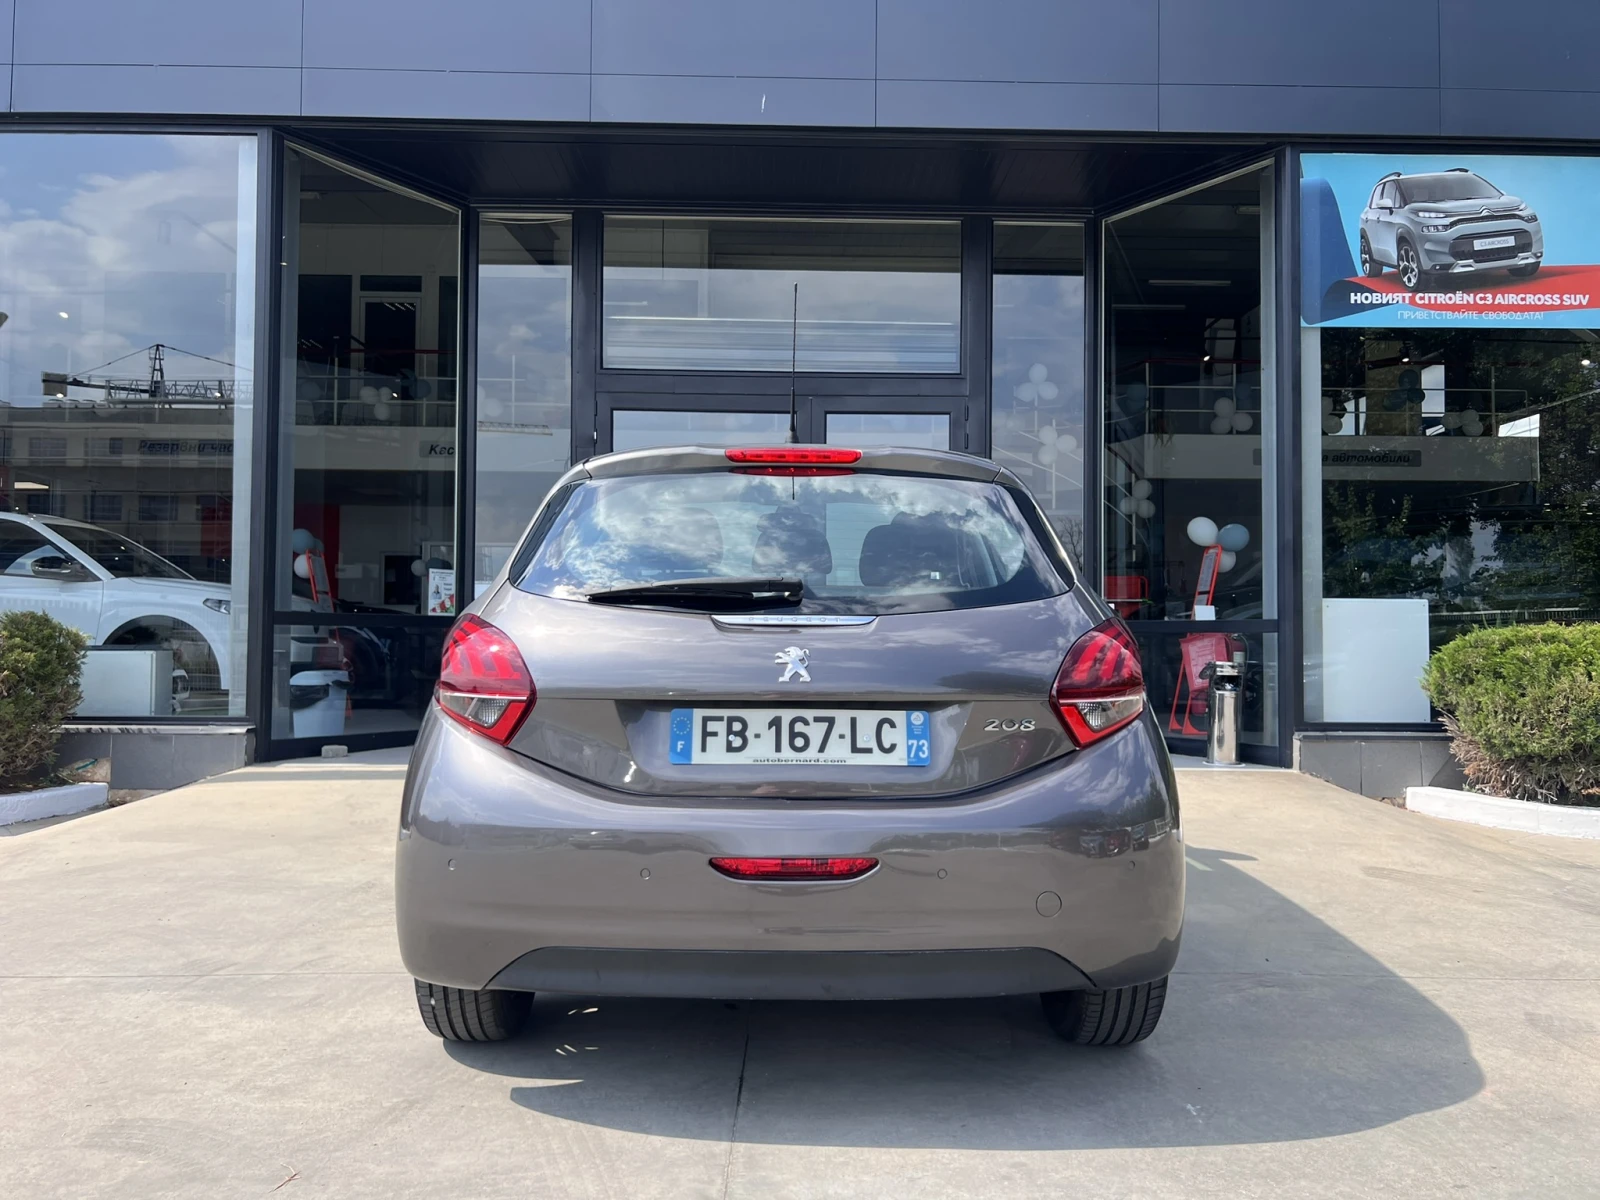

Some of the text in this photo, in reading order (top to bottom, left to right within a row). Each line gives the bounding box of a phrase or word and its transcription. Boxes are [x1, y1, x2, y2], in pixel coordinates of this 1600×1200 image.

[1350, 291, 1590, 306] НОВИЯТ CITROËN C3 AIRCROSS SUV
[1397, 309, 1545, 320] ПРИВЕТСТВАЙТЕ СВОБОДАТА!
[428, 443, 455, 456] Кас
[1331, 452, 1411, 464] автомобили
[984, 718, 1036, 731] 208
[701, 715, 898, 754] FB-167-LC
[676, 741, 685, 753] F
[908, 739, 929, 758] 73
